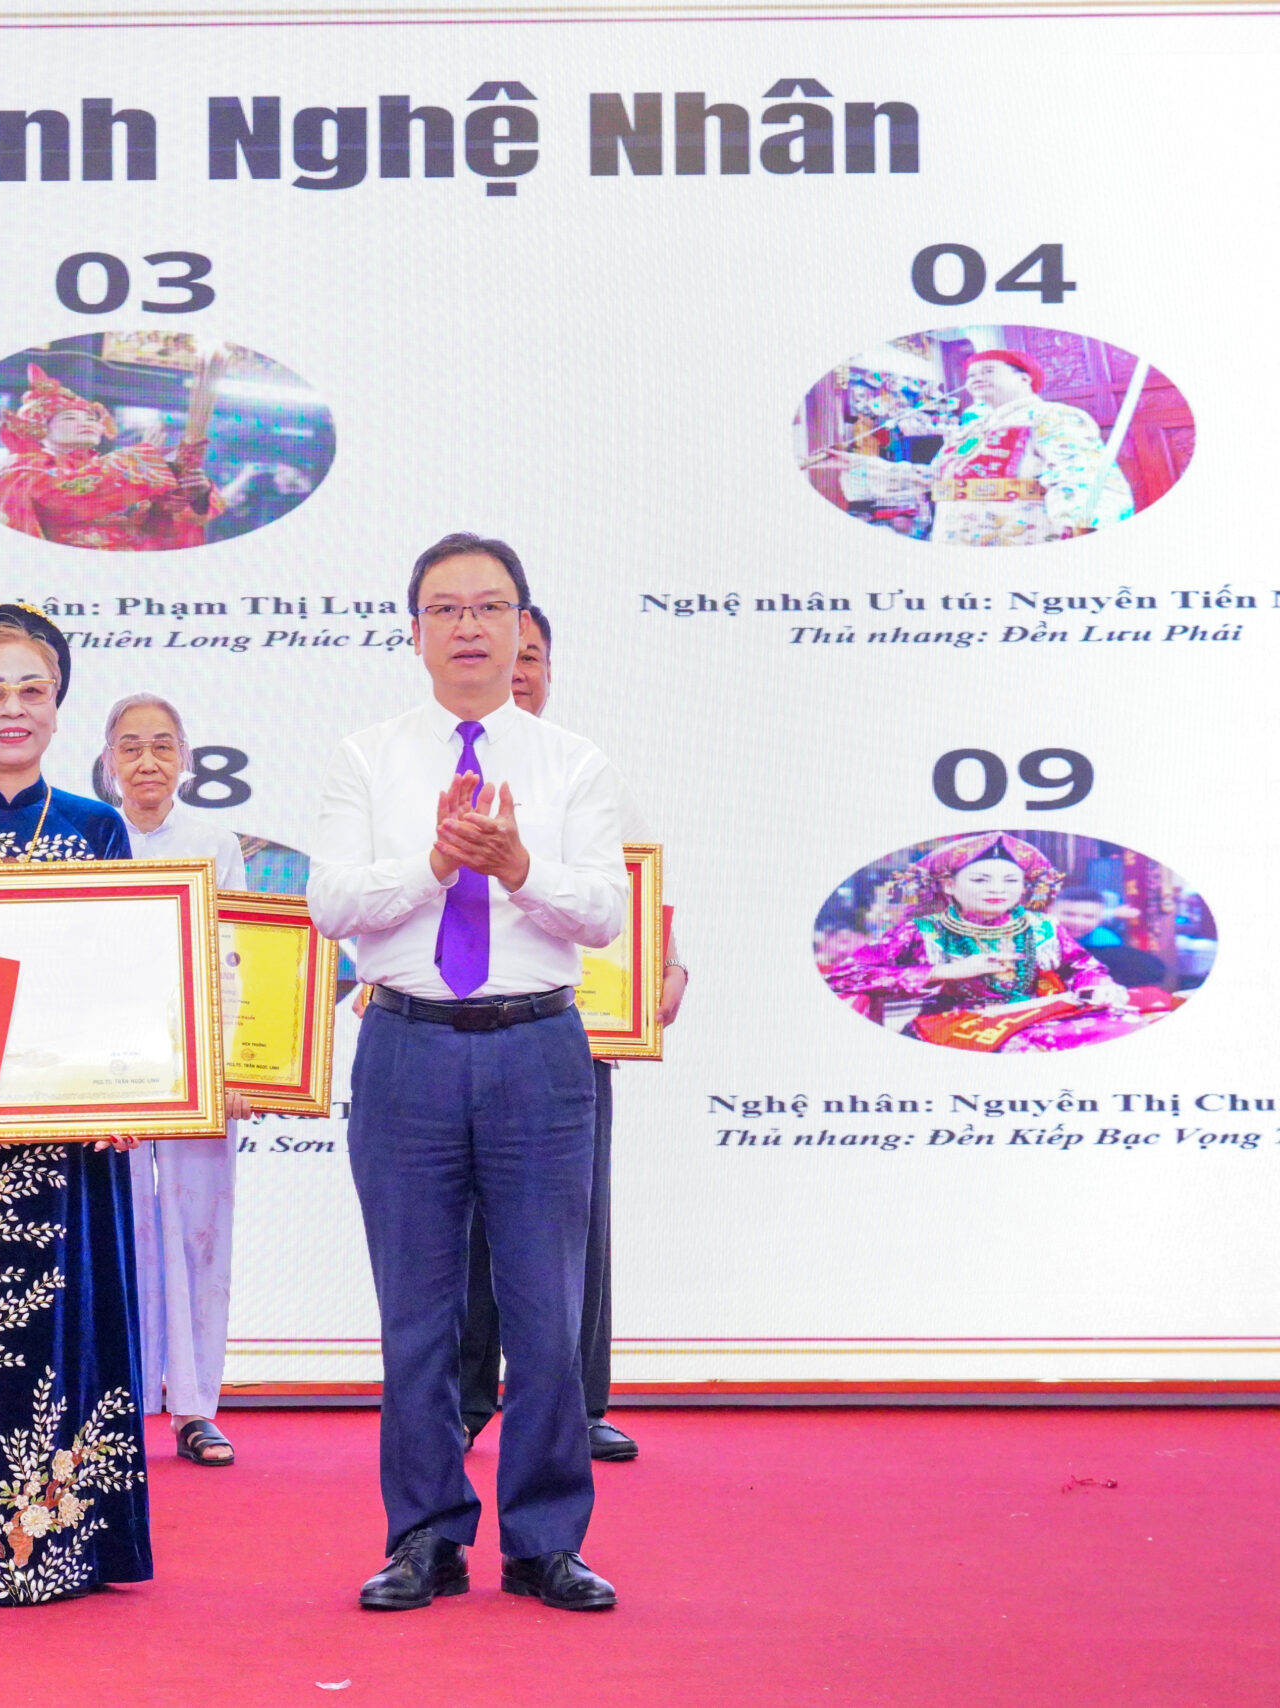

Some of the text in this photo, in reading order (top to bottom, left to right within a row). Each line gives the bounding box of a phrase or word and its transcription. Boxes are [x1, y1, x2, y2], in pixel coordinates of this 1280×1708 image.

[208, 80, 540, 197] Nghệ
[589, 77, 920, 177] Nhân
[55, 251, 216, 315] 03
[911, 243, 1077, 307] 04
[115, 597, 228, 621] Phạm
[240, 596, 308, 620] Thị
[321, 596, 398, 620] Lụa
[639, 592, 741, 618] Nghệ
[754, 591, 852, 612] nhân
[867, 588, 926, 611] Ưu
[940, 592, 992, 611] tú:
[1009, 585, 1158, 616] Nguyễn
[1170, 583, 1257, 610] Tiến
[63, 630, 153, 649] Thiên
[163, 631, 252, 653] Long
[261, 628, 350, 648] Phúc
[789, 620, 1244, 649] Thủ nhang: Đền Lưu Phái
[931, 747, 1095, 813] 09
[707, 1093, 809, 1119] Nghệ
[823, 1093, 934, 1114] nhân:
[949, 1088, 1099, 1118] Nguyễn
[1112, 1093, 1180, 1117] Thị
[269, 1135, 336, 1153] Sơn
[716, 1128, 782, 1147] Thủ
[792, 1129, 915, 1151] nhang:
[926, 1123, 995, 1146] Đền
[1006, 1123, 1084, 1151] Kiếp
[1093, 1128, 1161, 1150] Bạc
[1175, 1128, 1262, 1150] Vọng
